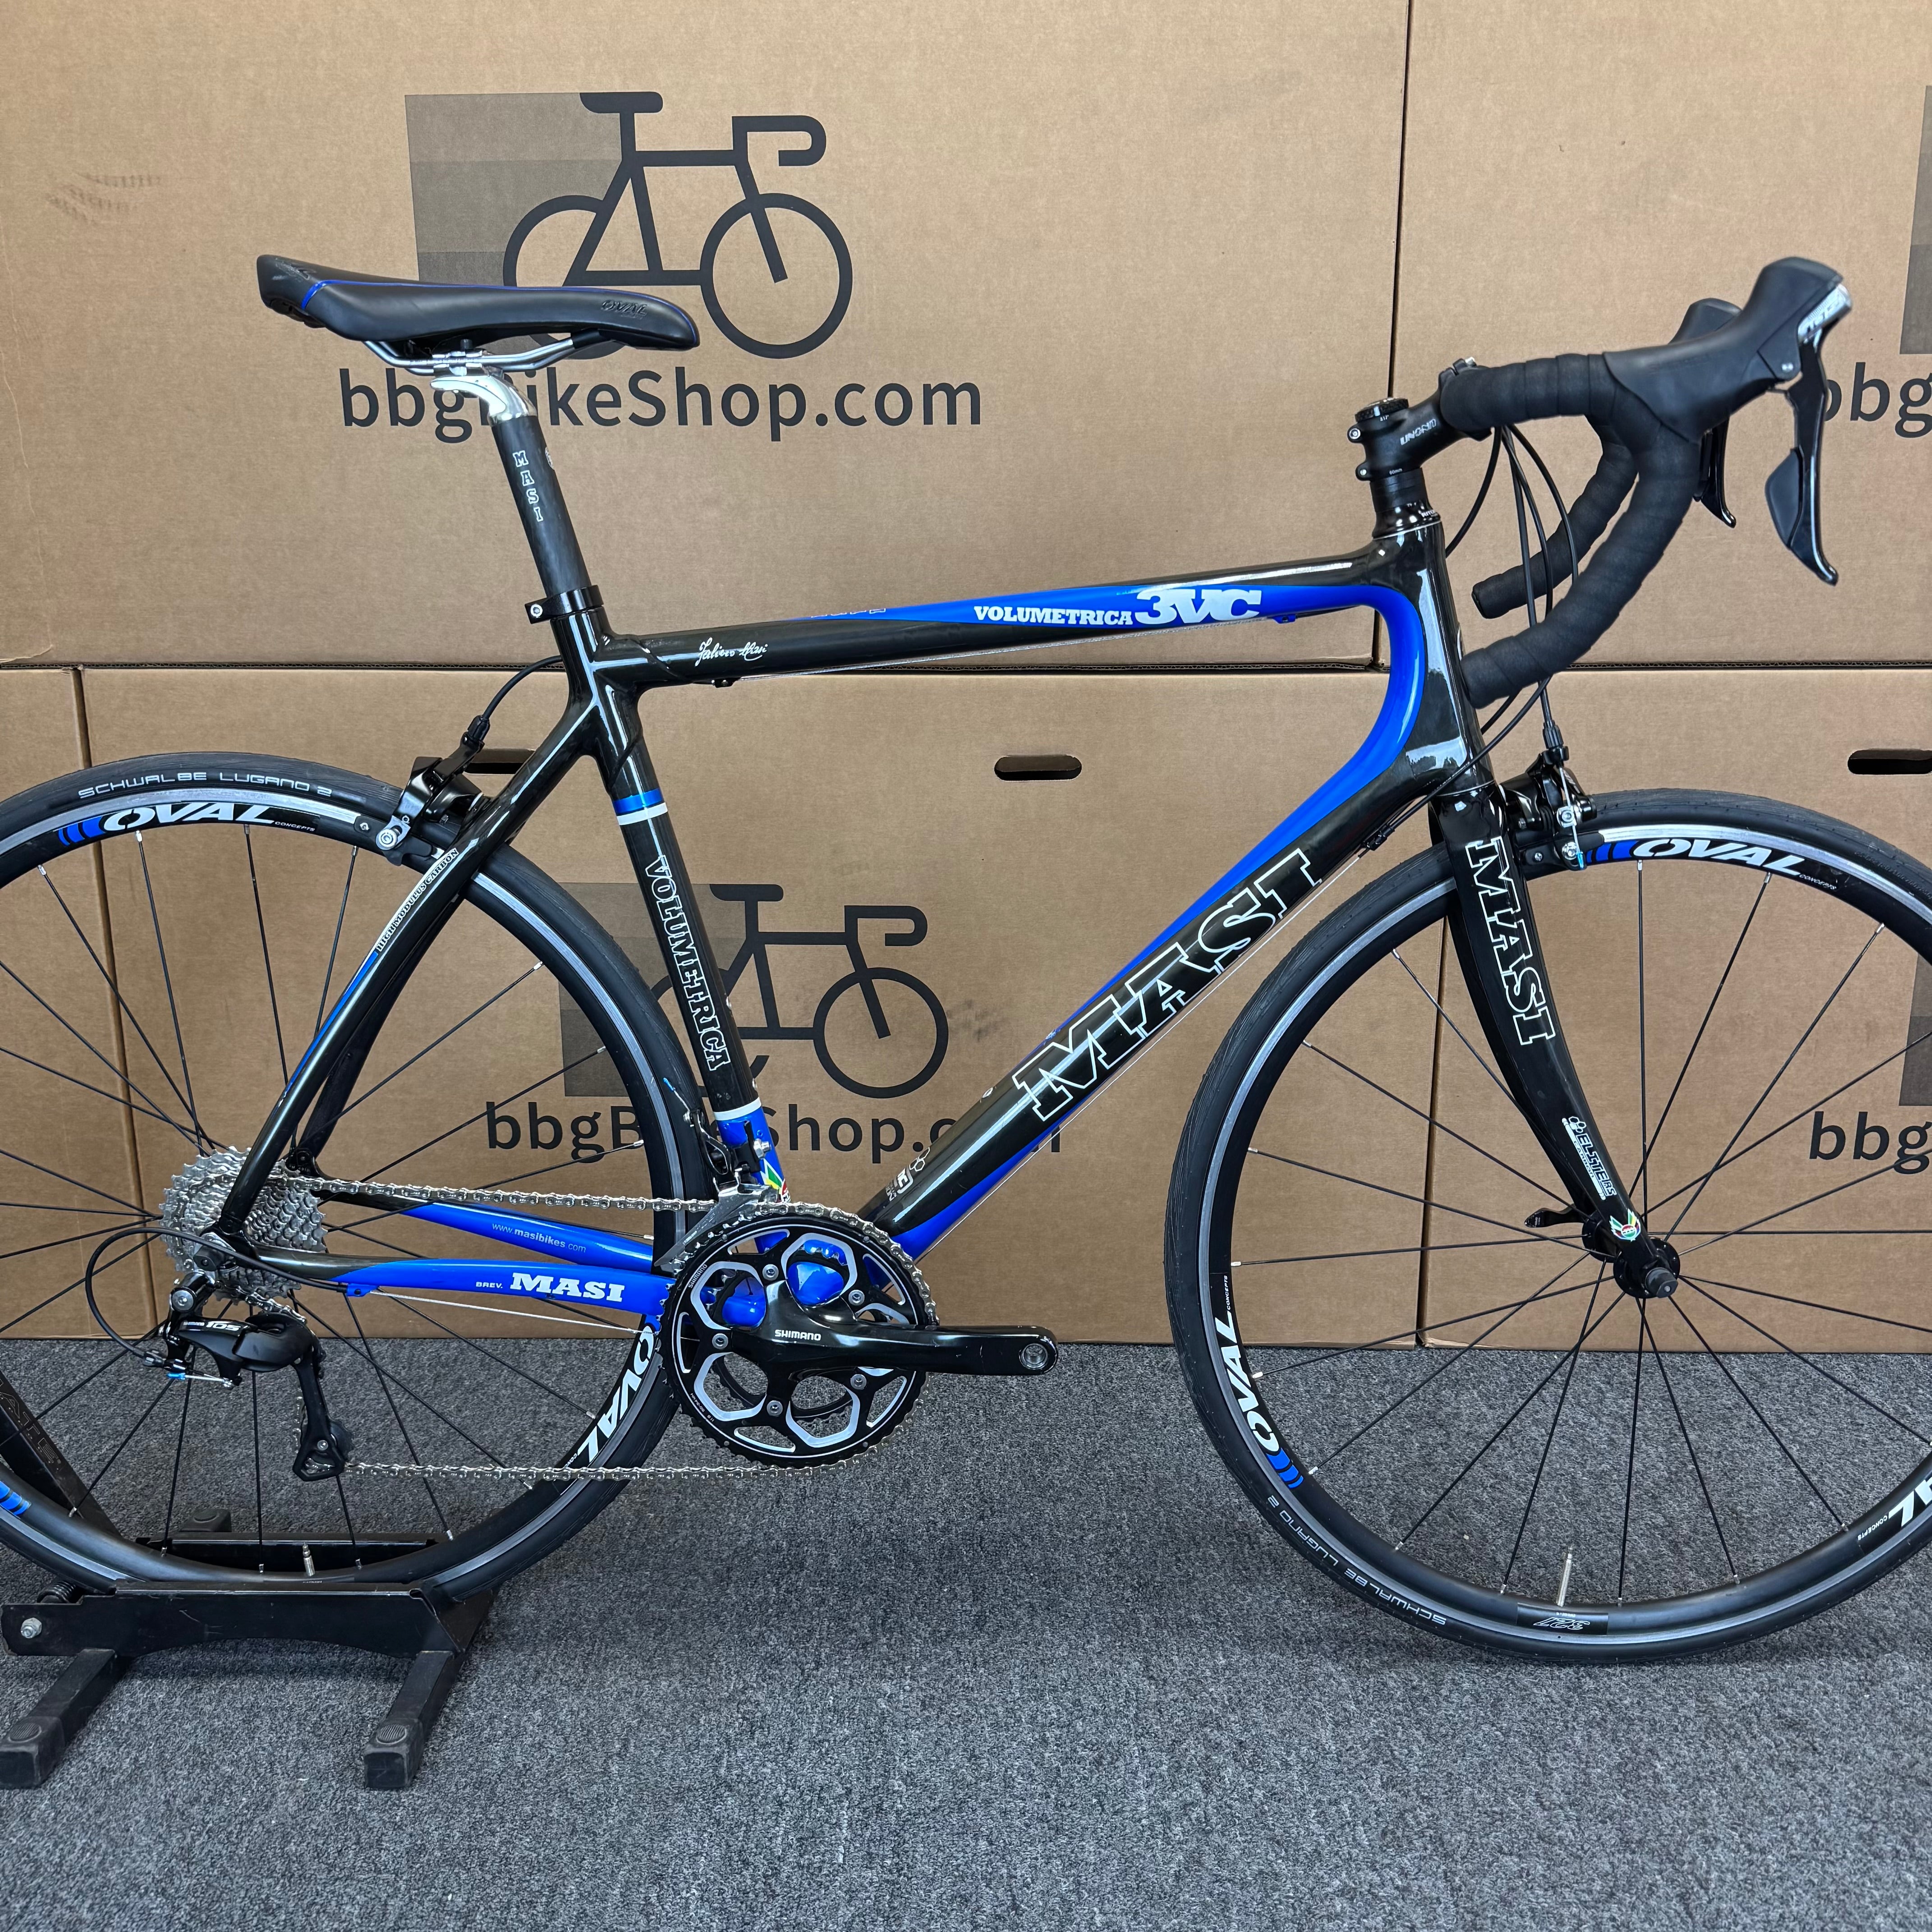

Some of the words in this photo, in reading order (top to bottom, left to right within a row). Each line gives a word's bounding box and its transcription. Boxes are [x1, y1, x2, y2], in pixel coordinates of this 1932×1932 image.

[601, 299, 648, 315] OVAL
[339, 366, 982, 443] bbgikeShop.com
[512, 450, 543, 522] MASI
[974, 606, 1133, 626] VOLUMETRICA
[1135, 589, 1262, 625] 3VC
[78, 772, 207, 799] SCHWALBE
[220, 773, 310, 791] LUGANO
[317, 786, 332, 796] 2
[104, 802, 276, 831] OVAL
[274, 821, 316, 832] CONCEPTS
[1633, 839, 1805, 876] OVAL
[1799, 874, 1837, 891] CONCEPTS
[377, 925, 396, 952] HIGH
[393, 882, 427, 928] MODULUS
[424, 847, 459, 885] CARBON
[1465, 836, 1556, 1045] MASI
[645, 855, 731, 1072] VOLUMETRICA
[1012, 848, 1322, 1121] MASI
[510, 1272, 625, 1302] MASI
[688, 1264, 708, 1288] SHIMANO
[206, 1320, 242, 1331] 105
[774, 1329, 821, 1341] SHIMANO
[577, 1325, 654, 1463] OVAL
[1215, 1311, 1279, 1452] OVAL
[1267, 1495, 1280, 1508] 2
[1279, 1509, 1339, 1566] LUGANO
[1857, 1515, 1888, 1541] CONCEPTS
[1345, 1569, 1447, 1625] SCHWALBE
[1533, 1617, 1591, 1630] 327
